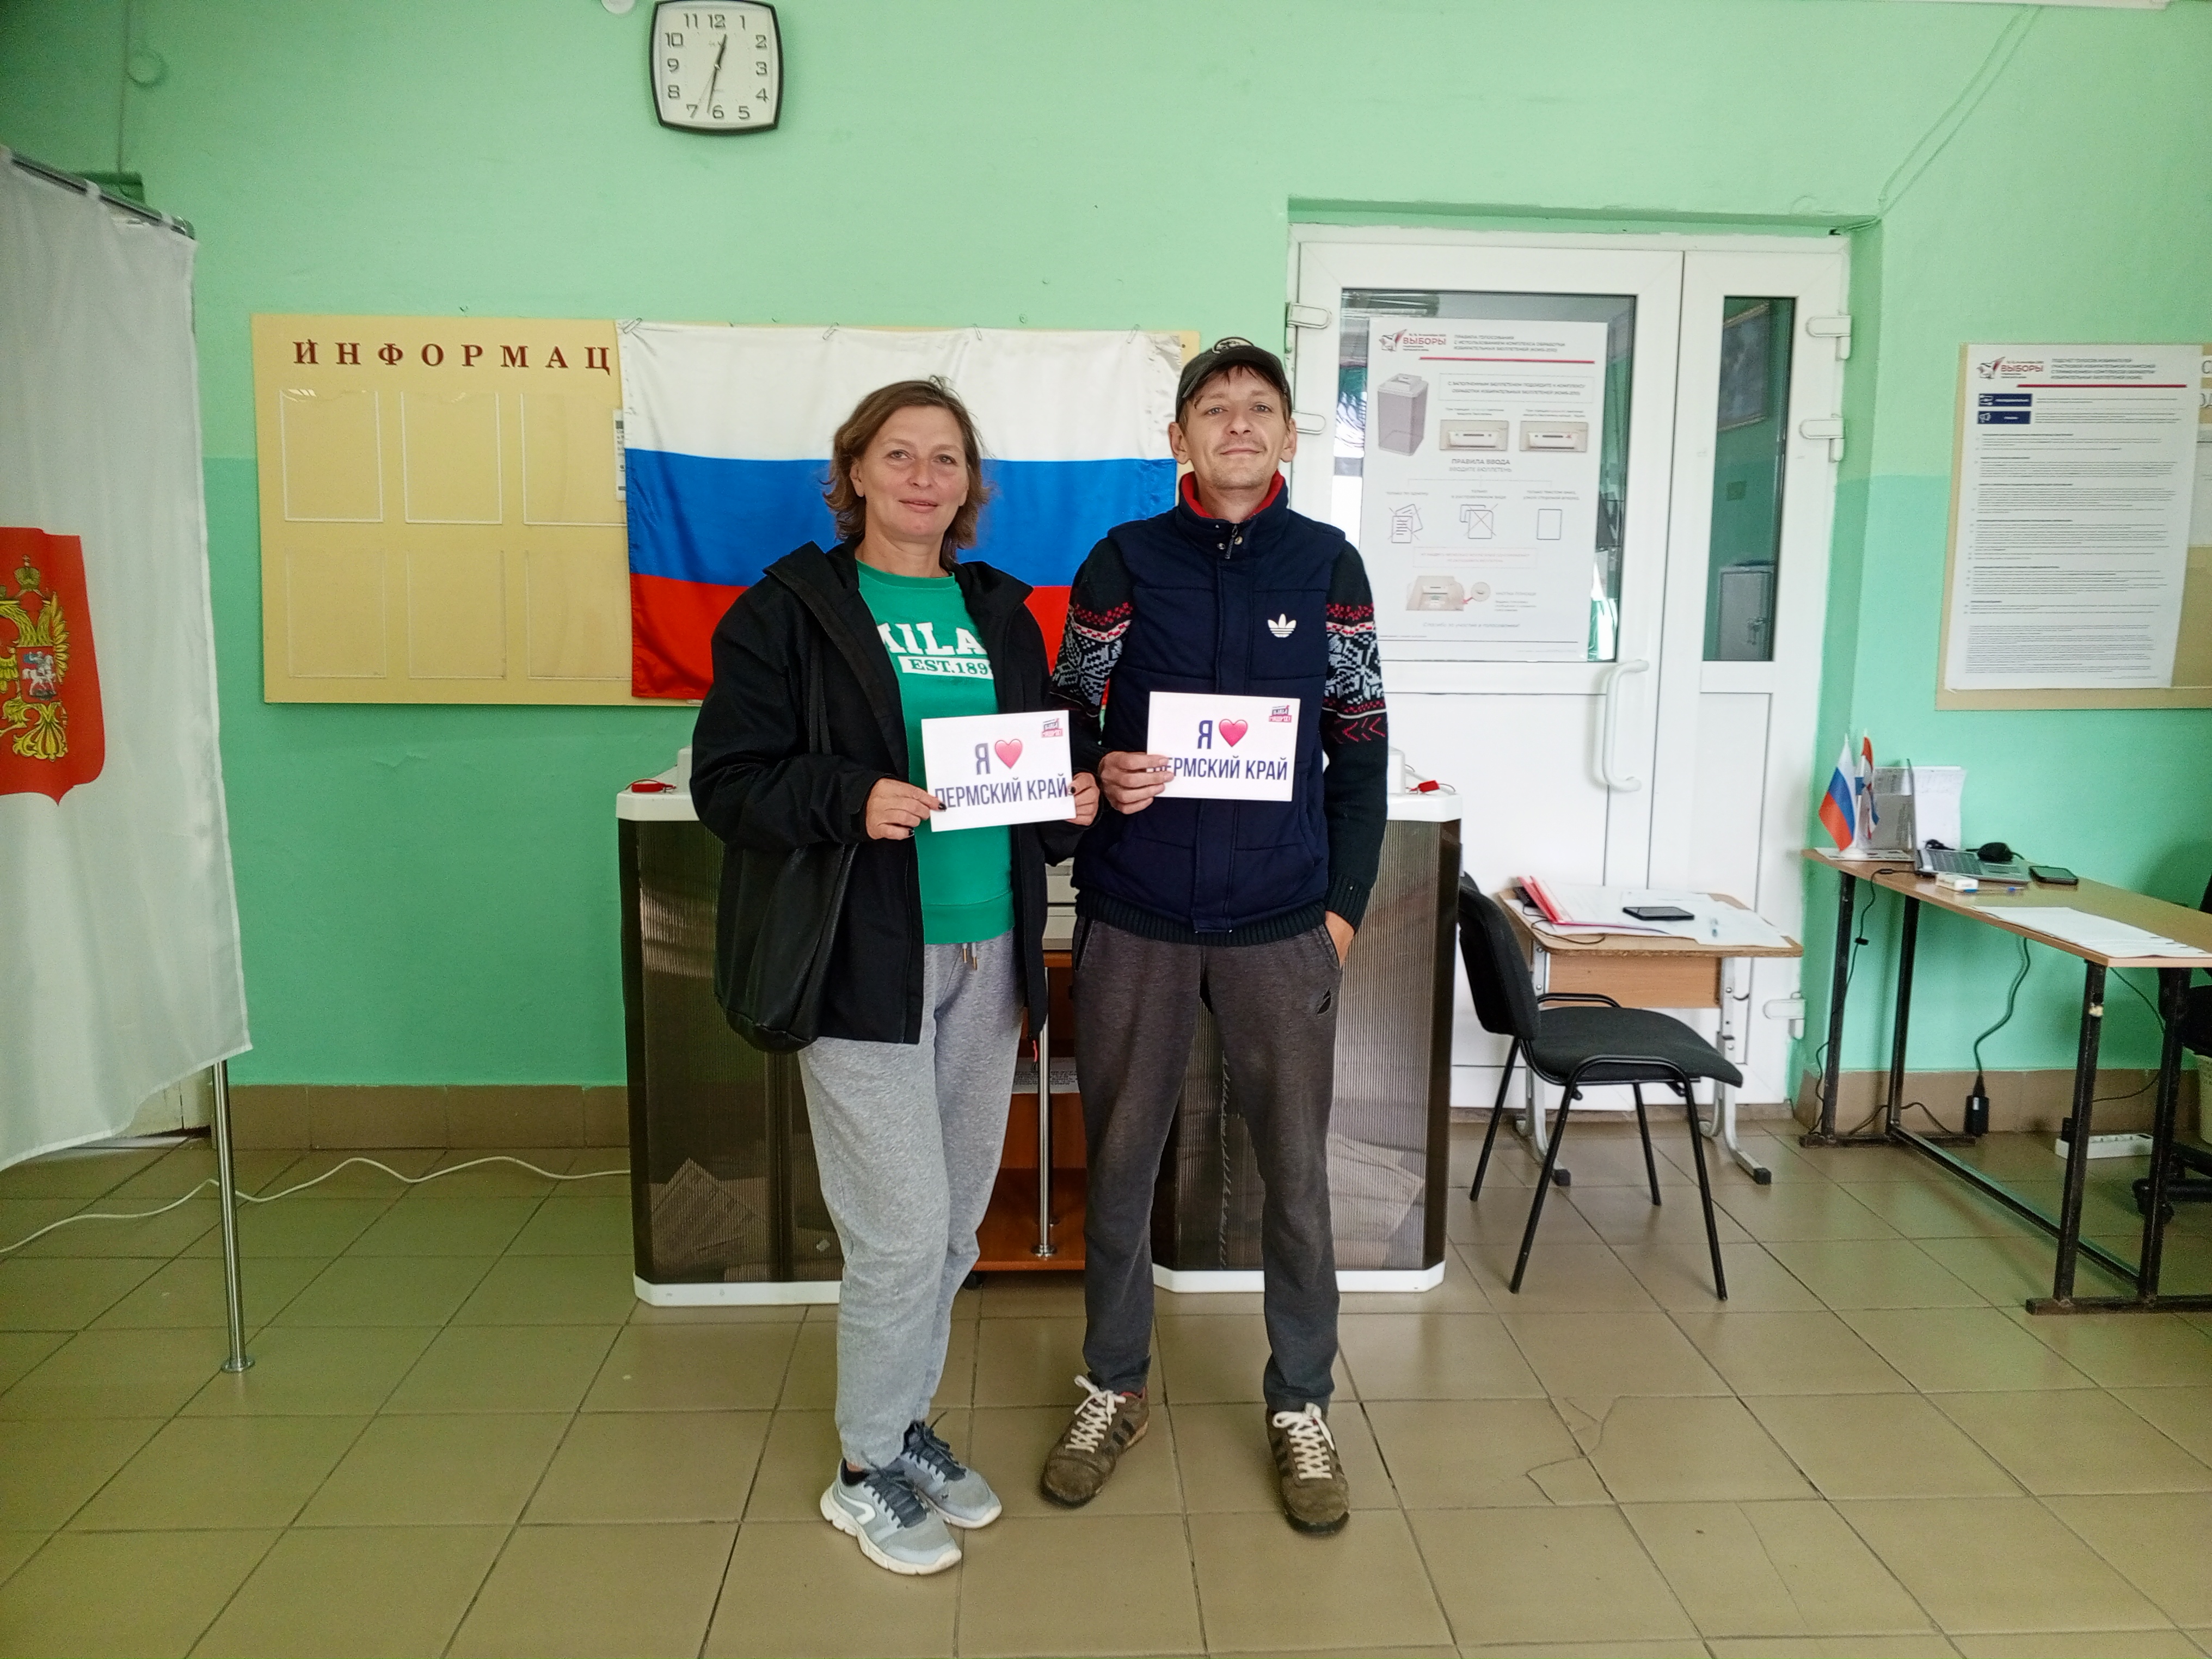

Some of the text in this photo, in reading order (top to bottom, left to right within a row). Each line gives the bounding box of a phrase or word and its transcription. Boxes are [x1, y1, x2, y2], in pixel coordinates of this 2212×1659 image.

[684, 13, 698, 29] 11
[708, 14, 726, 28] 12
[739, 15, 746, 30] 1
[665, 32, 684, 48] 10
[755, 34, 767, 48] 2
[667, 58, 679, 73] 9
[755, 61, 767, 76] 3
[667, 84, 680, 99] 8
[755, 88, 769, 102] 4
[686, 103, 698, 119] 7
[712, 105, 725, 119] 6
[738, 105, 751, 120] 5
[1403, 337, 1446, 345] ВЫБОРЫ
[293, 339, 611, 376] ИНФОРМАЦ
[908, 659, 991, 675] EST.189
[1197, 720, 1213, 749] Я
[975, 743, 991, 775] Я
[1153, 755, 1288, 780] РМСКИЙ КРАЙ
[1027, 773, 1068, 801] КРАЙ
